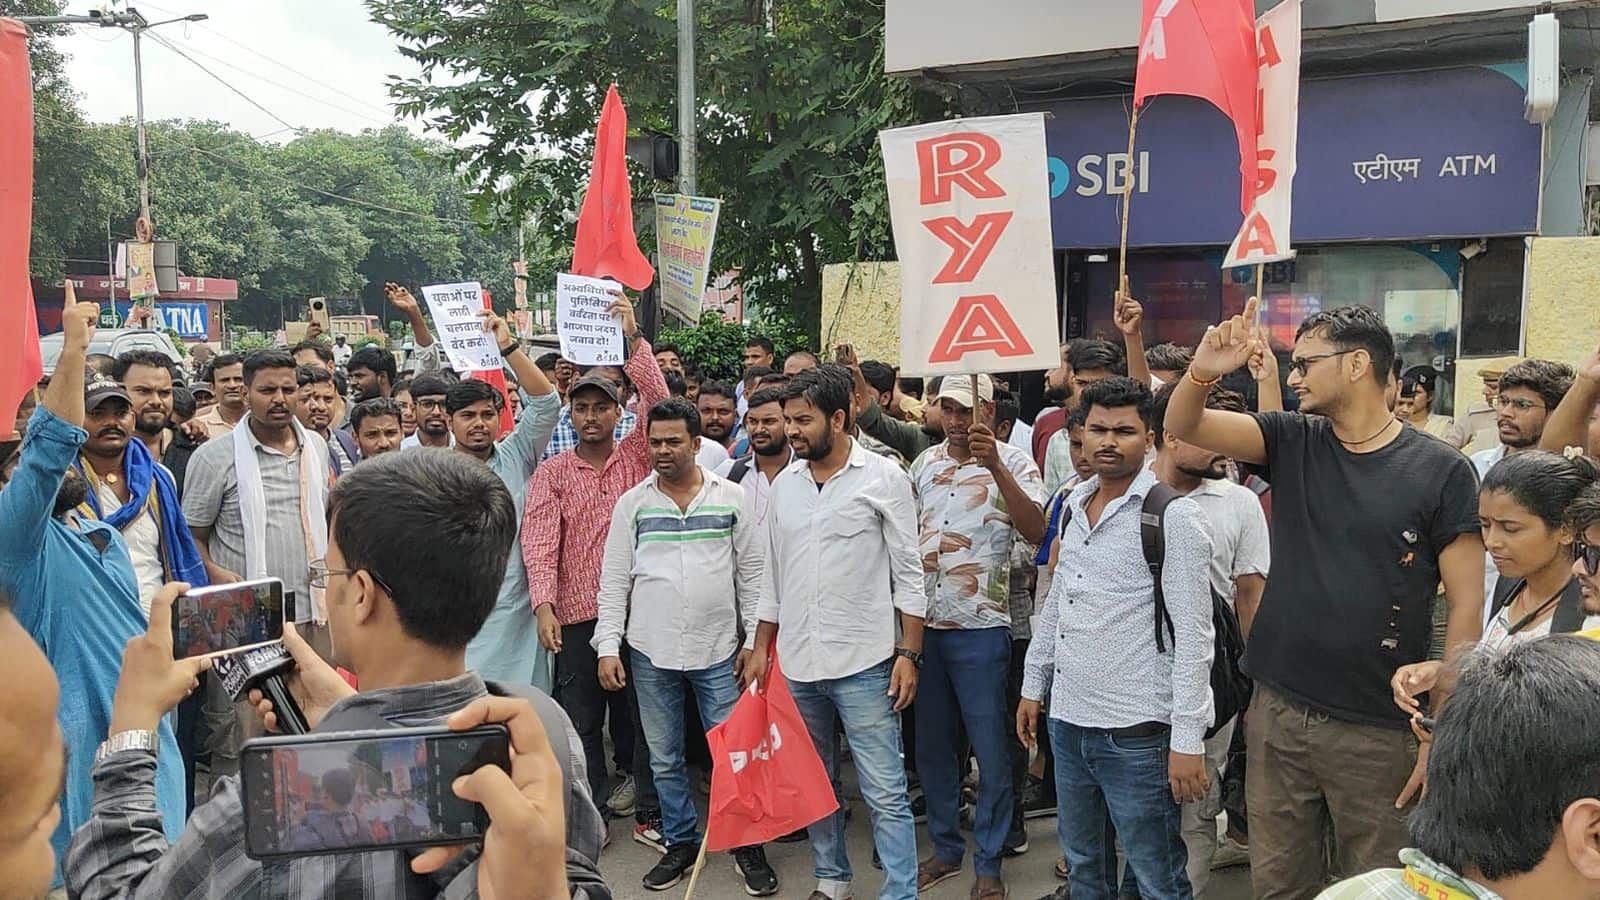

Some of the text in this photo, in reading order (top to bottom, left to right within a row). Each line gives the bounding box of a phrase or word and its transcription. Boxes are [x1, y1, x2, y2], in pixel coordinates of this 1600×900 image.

[1076, 151, 1150, 197] SBI
[1352, 153, 1496, 184] एटीएम ATM
[915, 131, 1035, 364] RYA
